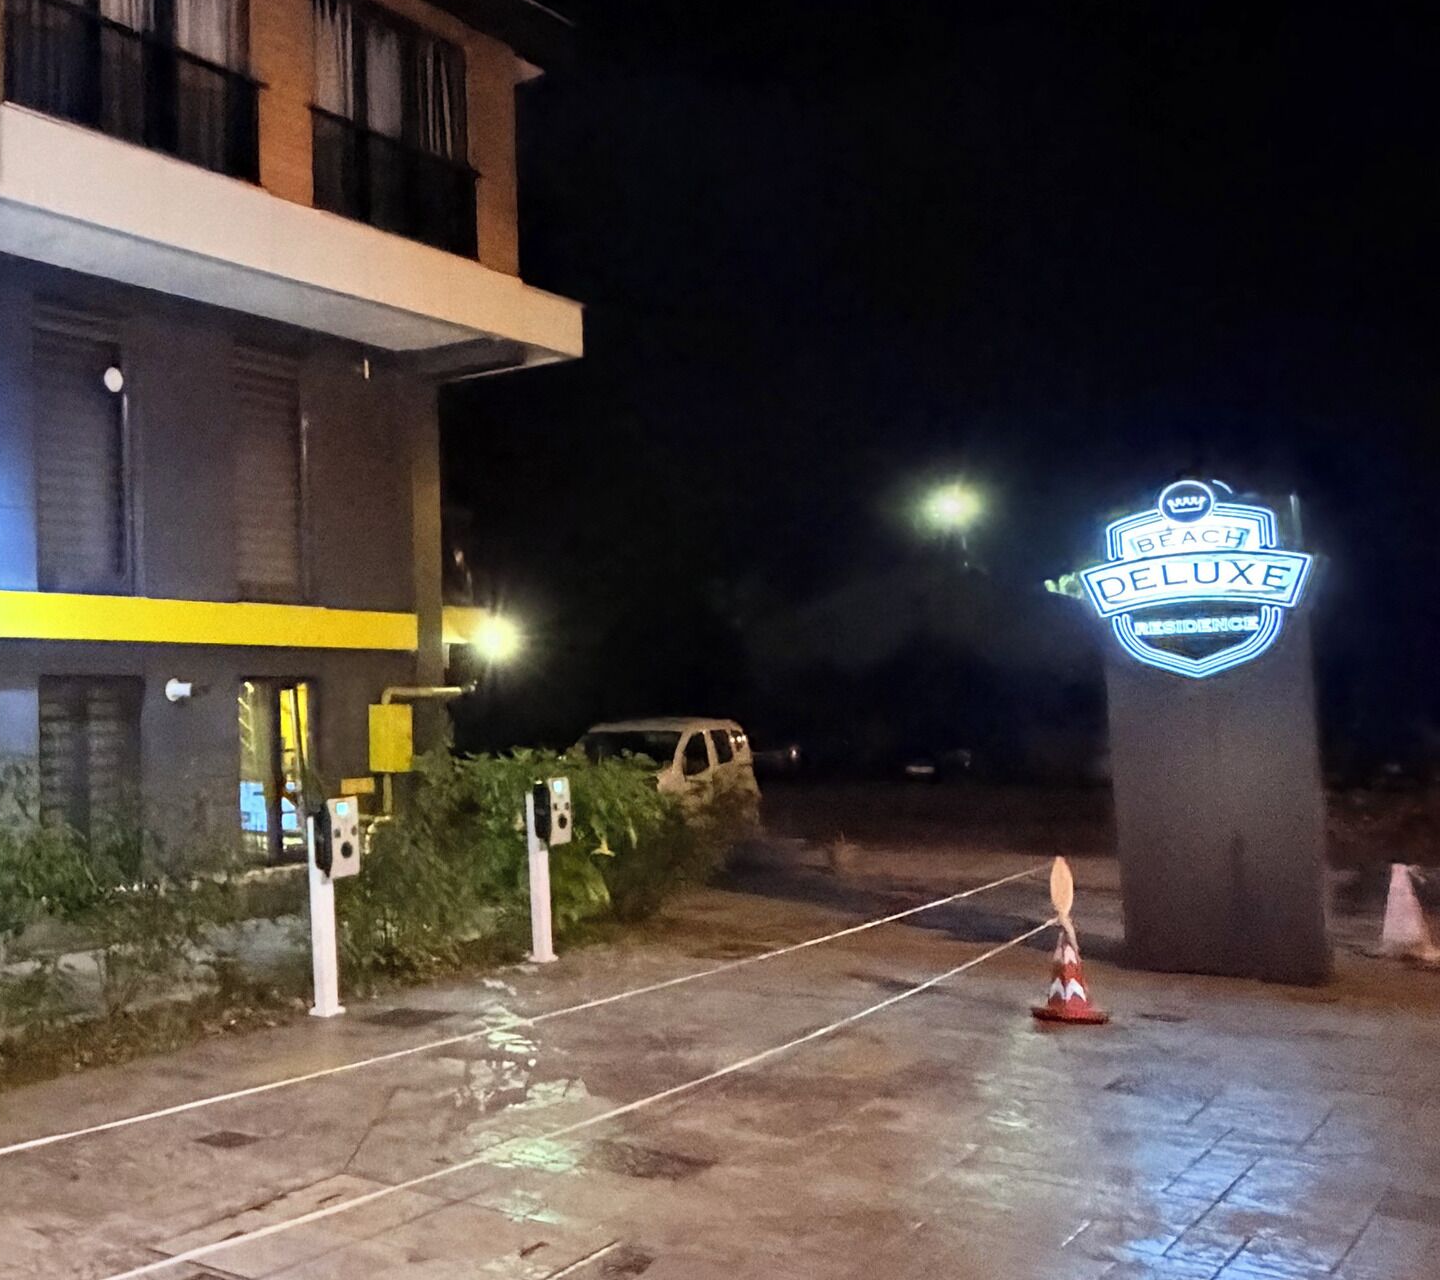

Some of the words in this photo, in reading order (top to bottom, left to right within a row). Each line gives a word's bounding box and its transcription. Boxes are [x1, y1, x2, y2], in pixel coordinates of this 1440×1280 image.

[1136, 527, 1245, 553] BEACH
[1096, 560, 1293, 602] DELUXE
[1133, 616, 1260, 636] RESIDENCE
